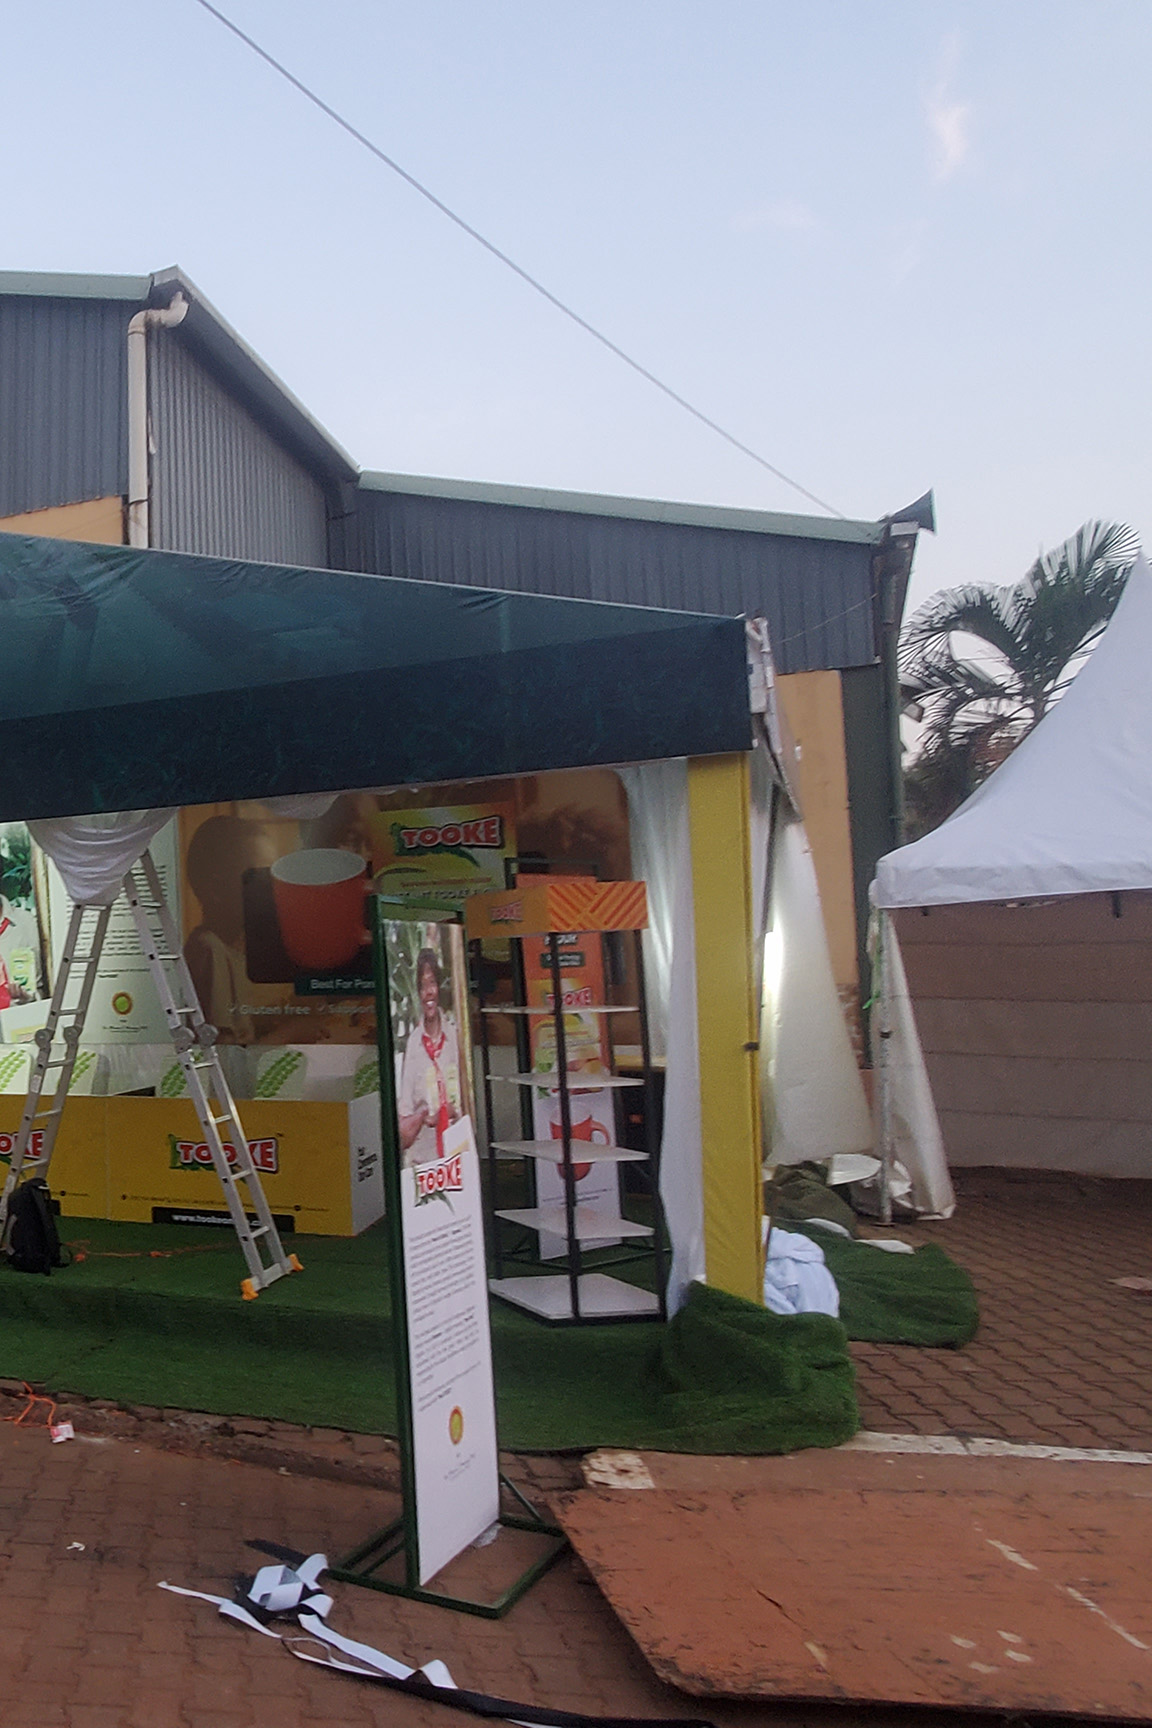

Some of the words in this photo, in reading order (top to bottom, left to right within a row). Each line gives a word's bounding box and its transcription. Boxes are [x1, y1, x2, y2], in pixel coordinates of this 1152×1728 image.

[400, 816, 501, 849] TOOKE
[240, 1004, 281, 1016] Gluten
[284, 1004, 310, 1015] free
[417, 1153, 463, 1199] TOOKE
